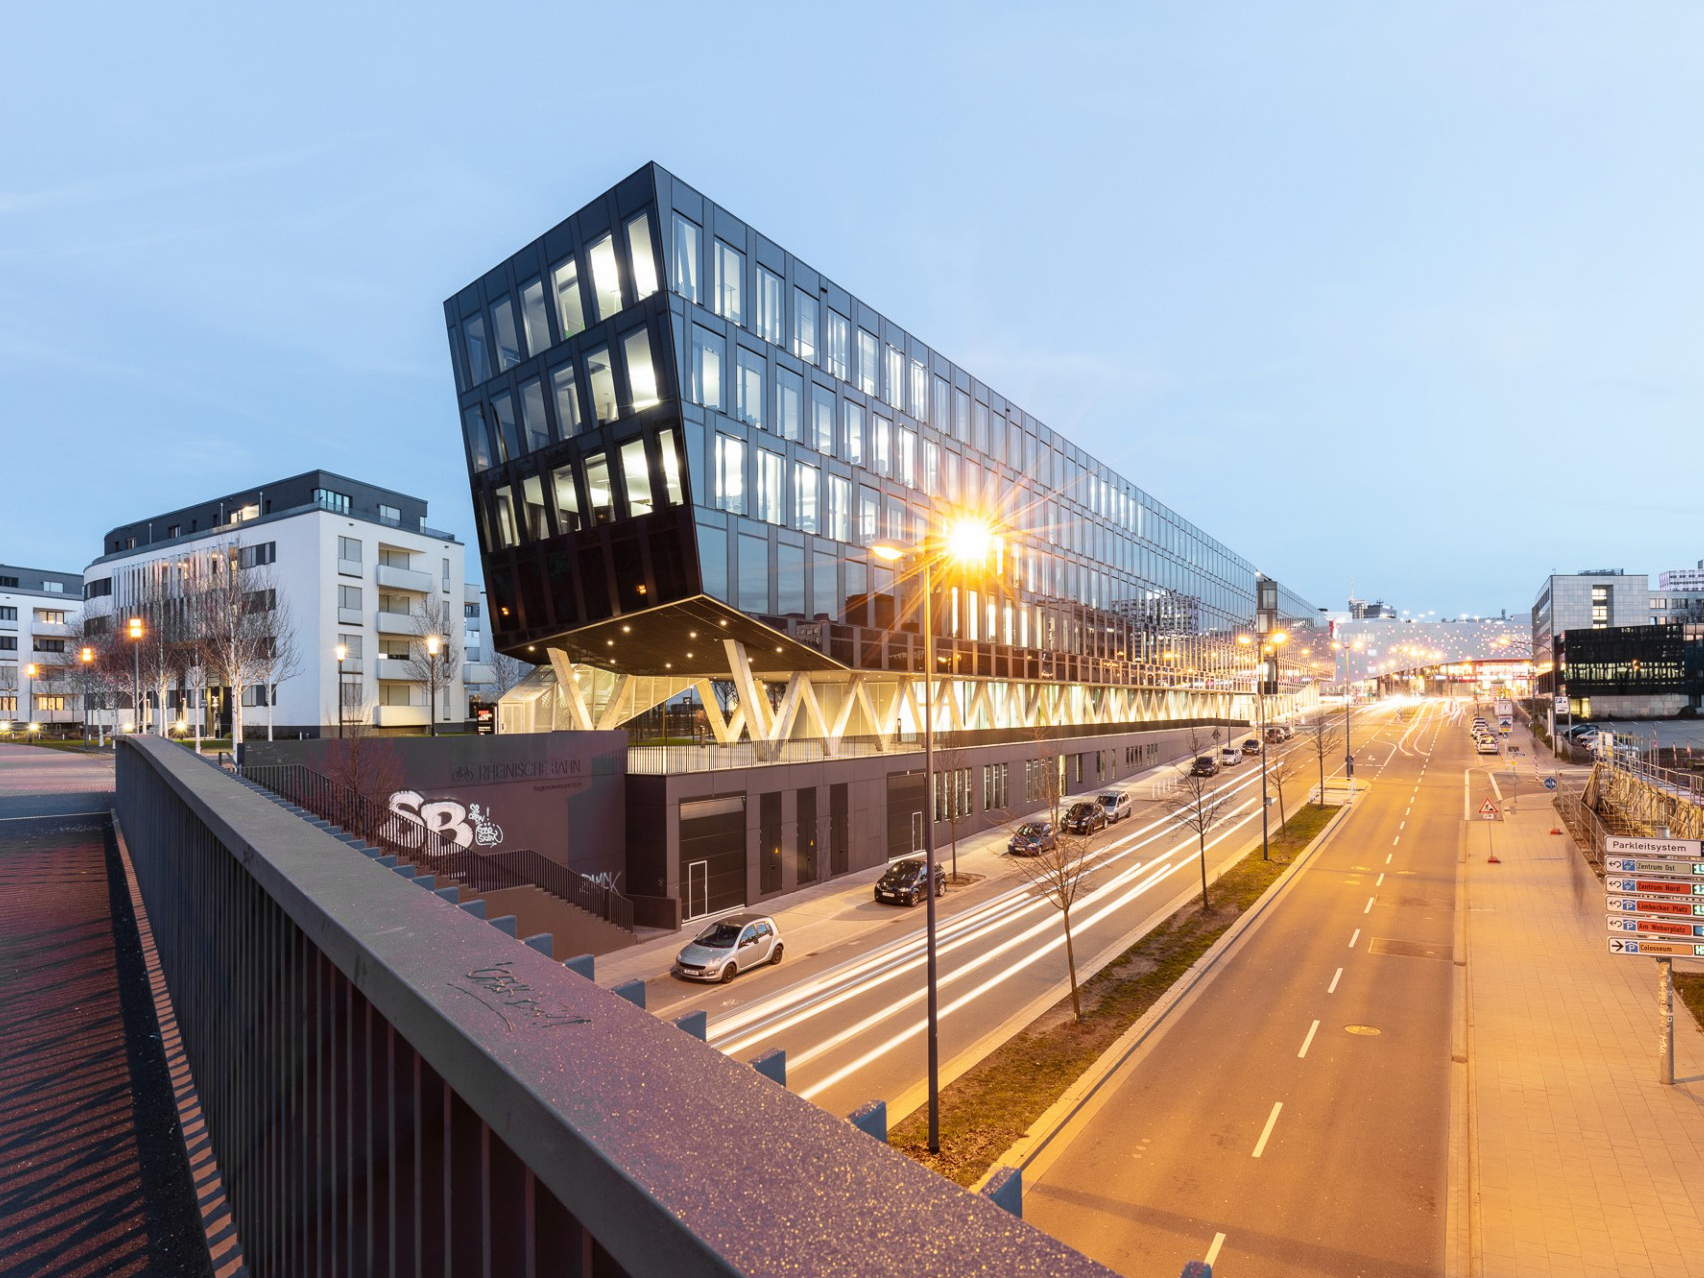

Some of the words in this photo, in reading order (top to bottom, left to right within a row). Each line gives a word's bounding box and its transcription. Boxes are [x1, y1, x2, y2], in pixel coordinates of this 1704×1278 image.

[479, 760, 548, 781] RHEINISCHE
[551, 759, 581, 775] BAHN
[1612, 841, 1687, 853] Parkleitsystem
[1637, 861, 1662, 870] Zentrum
[1637, 881, 1663, 891] Zentrum
[1665, 884, 1680, 892] Nord
[1637, 901, 1669, 912] Limbecker
[1672, 904, 1688, 913] Platz
[1638, 922, 1649, 930] Am
[1651, 923, 1686, 934] Weberplatz
[1640, 943, 1672, 953] Colosseum
